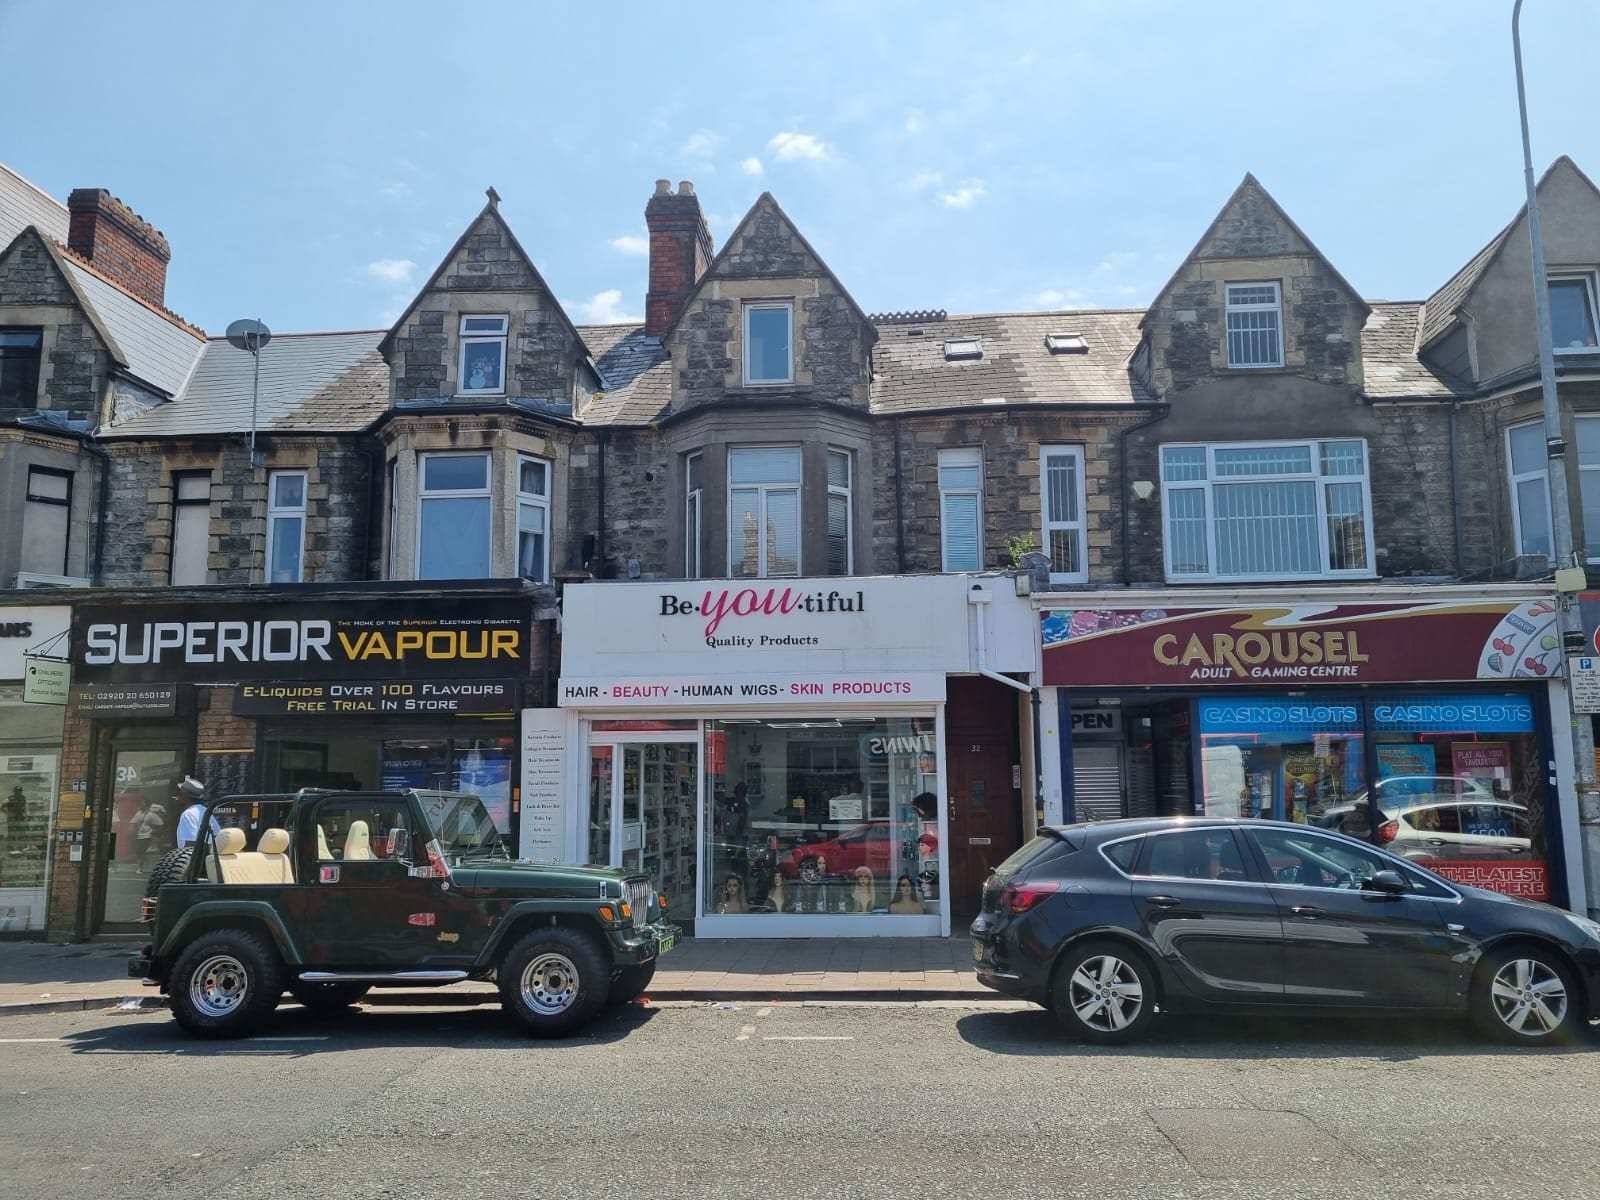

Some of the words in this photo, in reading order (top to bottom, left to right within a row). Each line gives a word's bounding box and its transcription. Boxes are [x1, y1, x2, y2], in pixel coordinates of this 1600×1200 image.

[85, 619, 332, 664] SUPERIOR
[337, 630, 521, 661] VAPOUR
[705, 634, 755, 648] Quality
[760, 634, 819, 647] Products
[1153, 631, 1370, 677] CAROUSEL
[1190, 667, 1233, 679] ADULT
[1251, 666, 1308, 678] GAMING
[1310, 665, 1359, 677] CENTRE
[97, 692, 124, 700] 02920
[243, 686, 323, 698] E-LIQUIDS
[330, 685, 373, 696] OVER
[381, 684, 413, 696] 100
[422, 684, 504, 696] FLAVOURS
[565, 686, 599, 698] HAIR
[612, 686, 669, 698] BEAUTY
[681, 685, 733, 697] HUMAN
[740, 684, 778, 696] WIGS
[790, 683, 824, 695] SKIN
[832, 682, 912, 695] PRODUCTS
[287, 700, 326, 711] FREE
[333, 700, 376, 711] TRIAL
[381, 699, 397, 710] IN
[404, 699, 458, 710] STORE
[1071, 713, 1113, 729] PEN
[1203, 707, 1287, 723] CASINO
[1288, 706, 1357, 723] SLOTS
[1373, 705, 1460, 724] CASINO
[1462, 704, 1533, 723] SLOTS
[1440, 867, 1476, 882] THE
[1477, 867, 1543, 882] LATEST
[1496, 881, 1545, 895] HERE
[436, 931, 460, 943] Jeep
